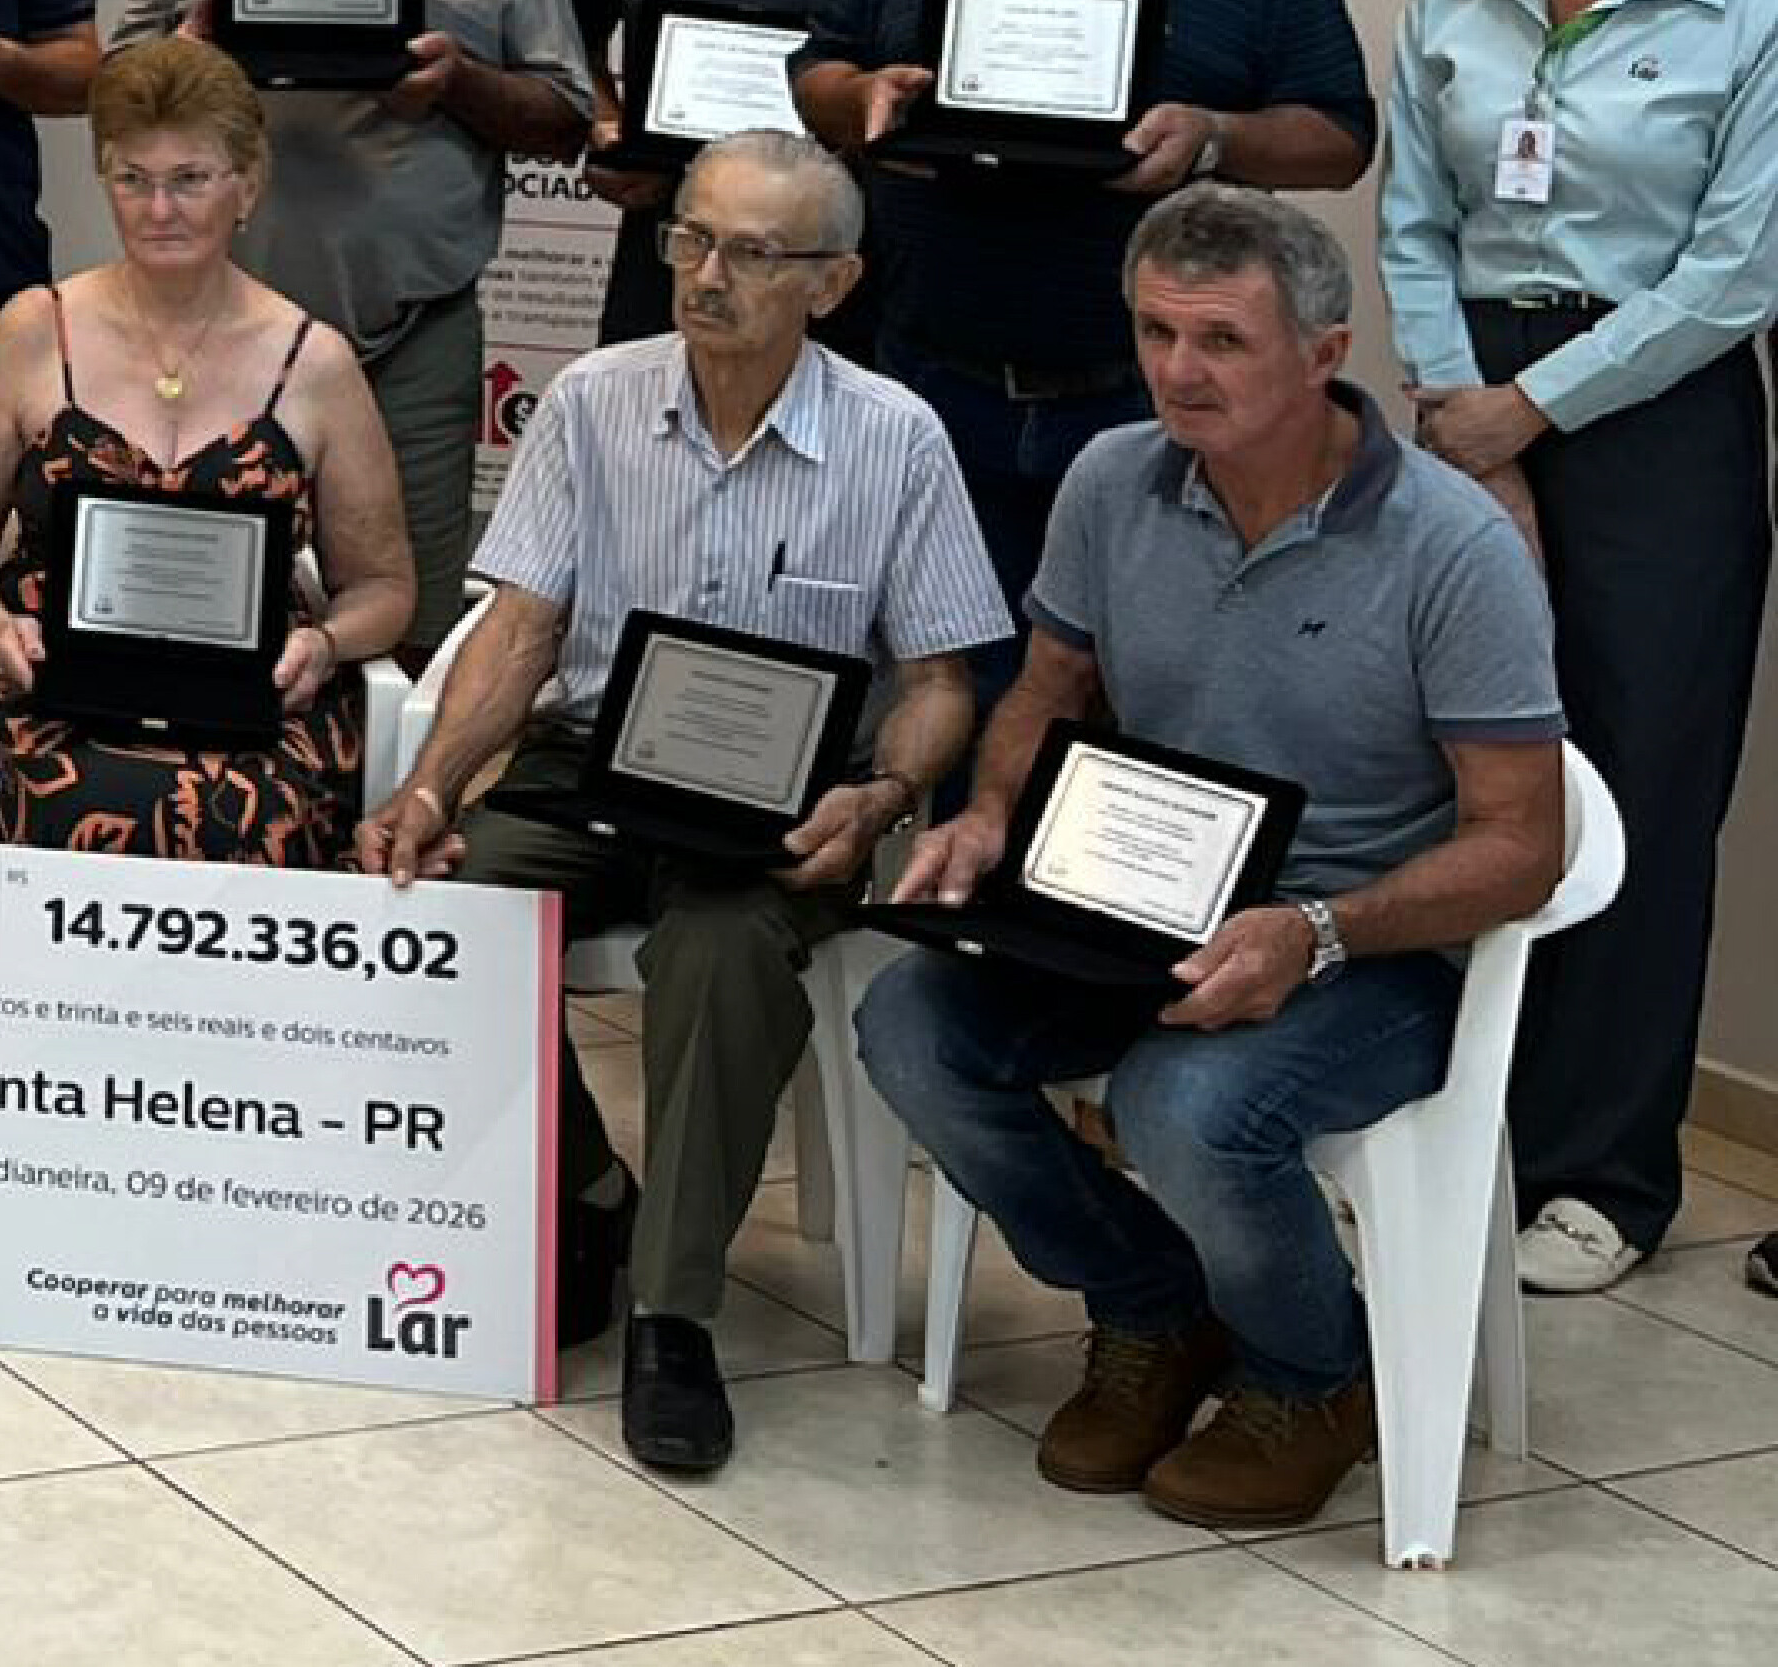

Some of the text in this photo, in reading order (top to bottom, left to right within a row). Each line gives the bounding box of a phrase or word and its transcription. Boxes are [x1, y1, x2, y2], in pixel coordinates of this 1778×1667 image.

[43, 897, 459, 981] 14.792.336,02
[34, 1001, 49, 1019] e
[57, 1001, 119, 1026] trinta
[125, 1010, 142, 1029] e
[147, 1011, 193, 1032] seis
[198, 1015, 256, 1039] reais
[261, 1021, 278, 1037] e
[282, 1019, 336, 1045] dois
[340, 1029, 453, 1058] centavos
[104, 1073, 304, 1139] Helena
[364, 1100, 446, 1152] PR
[126, 1170, 167, 1199] 09
[174, 1177, 214, 1205] de
[221, 1183, 353, 1219] fevereiro
[358, 1193, 400, 1222] de
[406, 1199, 487, 1230] 2026
[26, 1268, 346, 1321] Cooperar para melhorar
[93, 1301, 338, 1346] a vida das pessoas
[365, 1295, 473, 1360] Lar
